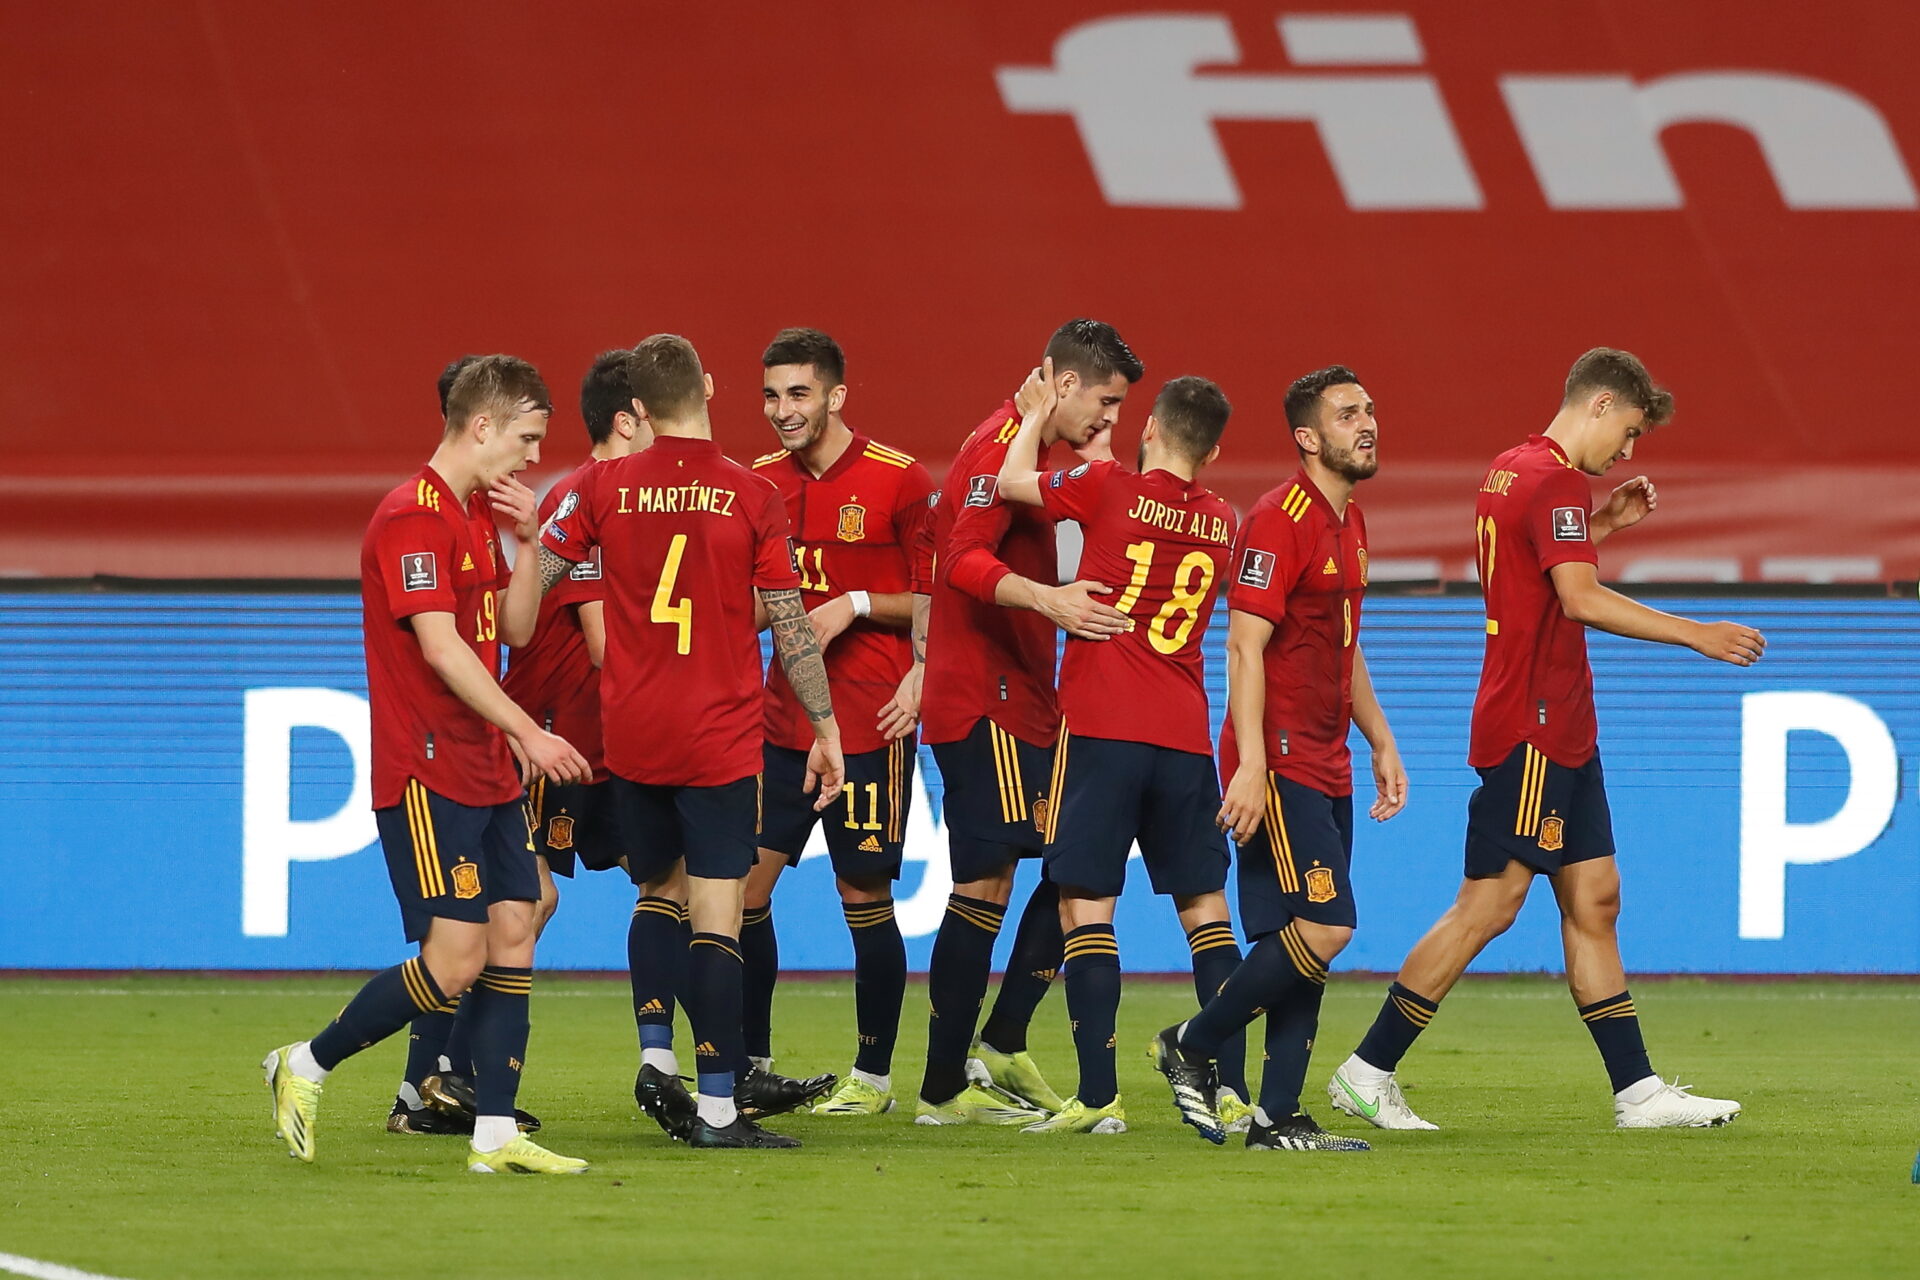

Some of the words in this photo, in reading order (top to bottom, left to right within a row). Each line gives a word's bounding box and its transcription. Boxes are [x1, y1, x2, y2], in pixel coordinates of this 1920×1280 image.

[617, 487, 632, 513] I.
[638, 480, 736, 516] MARTÍNEZ
[1128, 495, 1187, 533] JORDI
[1188, 513, 1229, 546] ALBA
[795, 546, 830, 592] 11
[476, 591, 496, 642] 19
[650, 534, 692, 655] 4
[1125, 541, 1215, 655] 18
[1343, 598, 1352, 647] 8
[842, 782, 882, 830] 11
[858, 844, 882, 853] adidas
